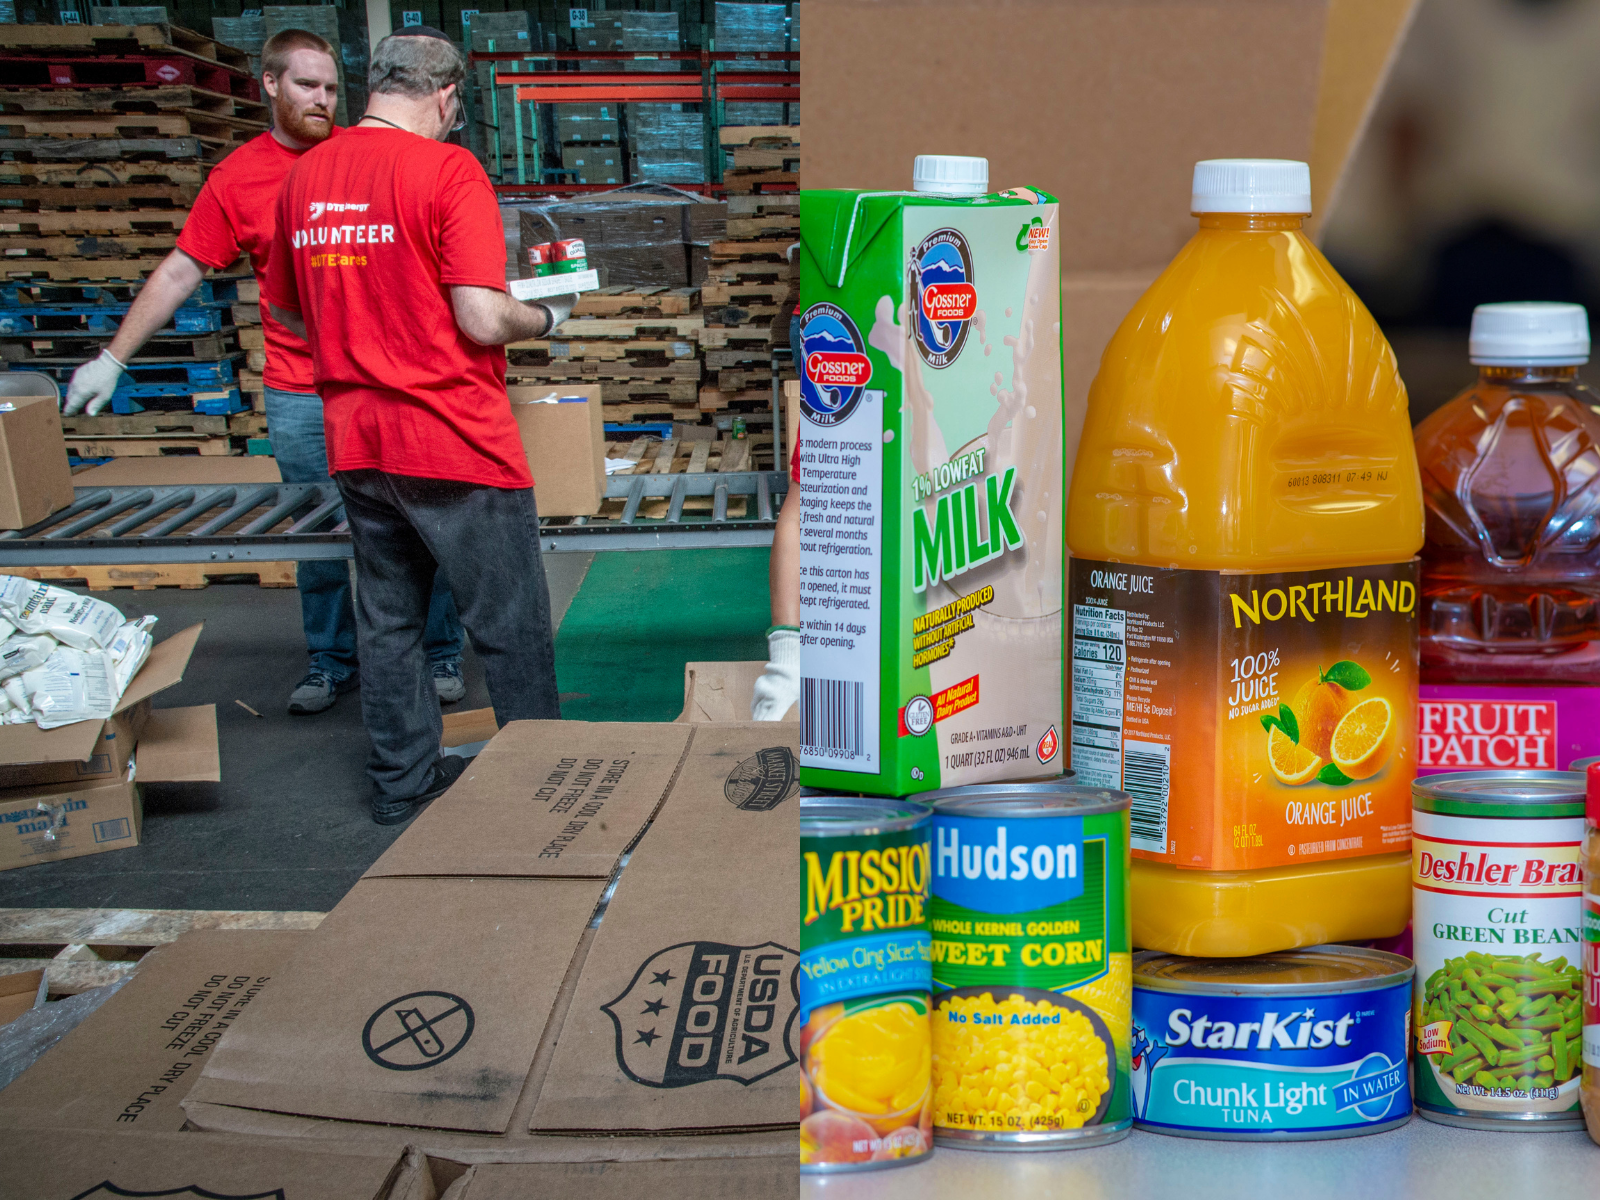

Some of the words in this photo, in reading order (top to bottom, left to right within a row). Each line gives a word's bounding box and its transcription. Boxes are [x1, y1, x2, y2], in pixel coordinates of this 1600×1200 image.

[405, 13, 420, 23] G-40
[572, 10, 586, 21] G-38
[292, 224, 395, 249] VOLUNTEER
[1028, 227, 1050, 238] NEW!
[922, 232, 962, 252] Premium
[310, 252, 368, 268] #DTEares
[925, 286, 972, 319] Gossner
[804, 305, 843, 323] Premium
[937, 309, 964, 317] FOODS
[808, 353, 865, 382] Gossner
[927, 353, 948, 365] Milk
[823, 374, 857, 383] FOODS
[811, 411, 836, 423] Milk
[805, 438, 838, 450] modern
[840, 441, 873, 452] process
[818, 453, 839, 464] Ultra
[841, 454, 861, 467] High
[802, 467, 857, 480] Temperature
[912, 473, 932, 503] 1%
[933, 447, 986, 494] LOWFAT
[1312, 472, 1341, 485] 808311
[851, 485, 868, 496] and
[830, 498, 856, 512] keeps
[857, 500, 872, 511] the
[802, 511, 824, 524] fresh
[825, 514, 842, 524] and
[843, 515, 875, 526] natural
[804, 528, 834, 539] several
[835, 529, 868, 540] months
[912, 465, 1024, 594] MILK
[818, 542, 873, 556] refrigeration.
[809, 566, 824, 577] this
[825, 568, 852, 579] carton
[854, 568, 870, 580] has
[1090, 569, 1128, 591] ORANGE
[1128, 574, 1155, 595] JUICE
[807, 582, 840, 595] opened,
[849, 584, 872, 595] must
[818, 596, 871, 610] refrigerated.
[913, 602, 957, 635] NATURALLY
[956, 585, 994, 617] PRODUCED
[1229, 576, 1416, 629] NORTHLAND
[1075, 604, 1103, 619] Nutrition
[1104, 609, 1125, 621] Facts
[806, 619, 832, 631] within
[834, 622, 844, 632] 14
[846, 622, 867, 636] days
[913, 626, 944, 652] WITHOUT
[943, 613, 975, 640] ARTIFICIAL
[820, 636, 856, 650] opening.
[1074, 645, 1098, 659] Calories
[1102, 643, 1122, 662] 120
[1230, 647, 1281, 683] 100%
[936, 692, 947, 708] All
[946, 678, 974, 703] Natural
[1228, 672, 1279, 706] JUICE
[936, 702, 954, 719] Dairy
[953, 690, 977, 711] Product
[1126, 701, 1143, 713] ME/HI
[1151, 704, 1173, 717] Deposit
[1228, 707, 1240, 720] NO
[1240, 702, 1261, 716] SUGAR
[911, 718, 928, 726] FREE
[1419, 702, 1548, 735] FRUIT
[950, 731, 969, 745] GRADE
[976, 727, 1002, 741] VITAMINS
[1016, 724, 1028, 736] UHT
[827, 748, 856, 760] 09908
[950, 751, 974, 770] QUART
[974, 750, 986, 768] (32
[994, 747, 1006, 764] OZ)
[1006, 746, 1019, 761] 946
[1019, 744, 1030, 760] mL
[1419, 734, 1549, 767] PATCH
[556, 758, 578, 769] DO
[583, 758, 604, 770] DO
[601, 759, 631, 784] STORE
[765, 751, 787, 781] MARKET
[544, 770, 570, 787] NOT
[571, 771, 597, 788] NOT
[532, 787, 558, 802] CUT
[594, 785, 616, 794] IN
[749, 782, 784, 808] STREET
[549, 788, 586, 814] FREEZE
[574, 801, 605, 819] COOL
[1285, 800, 1337, 826] ORANGE
[1340, 792, 1374, 827] JUICE
[1160, 801, 1168, 833] 53792
[561, 820, 589, 836] DRY
[1233, 825, 1241, 837] 64
[1248, 823, 1257, 836] OZ
[538, 835, 576, 859] PLACE
[937, 826, 1078, 881] Hudson
[1418, 850, 1520, 886] Deshler
[840, 893, 926, 933] PRIDE
[1487, 906, 1529, 925] Cut
[932, 919, 972, 935] WHOLE
[974, 922, 1025, 937] KERNEL
[1026, 920, 1081, 937] GOLDEN
[1432, 922, 1506, 945] GREEN
[930, 939, 1011, 967] WEET
[1020, 938, 1103, 967] CORN
[800, 956, 850, 980] Yellow
[204, 974, 228, 988] DO
[227, 975, 251, 990] DO
[736, 965, 749, 1007] DEPARTMENT
[183, 990, 213, 1010] NOT
[206, 991, 236, 1012] NOT
[221, 1009, 242, 1020] IN
[678, 954, 730, 1068] FOOD
[737, 954, 784, 1066] USDA
[948, 1011, 967, 1024] No
[972, 1012, 1003, 1025] Salt
[1010, 1012, 1061, 1026] Added
[160, 1011, 190, 1032] CUT
[212, 1021, 230, 1030] A
[1165, 1007, 1355, 1051] StarKist
[165, 1013, 215, 1051] FREEZE
[725, 1018, 740, 1064] AGRICULTURE
[1422, 1026, 1439, 1038] Low
[183, 1032, 222, 1058] COOL
[1419, 1036, 1448, 1050] Sodium
[159, 1062, 193, 1084] DRY
[1343, 1086, 1360, 1103] IN
[1362, 1070, 1401, 1097] WATER
[1455, 1083, 1469, 1095] Net
[1469, 1085, 1488, 1097] Wt.
[1489, 1087, 1511, 1098] 14.5
[1513, 1088, 1528, 1098] oz.
[1529, 1086, 1560, 1099] (411g)
[116, 1085, 168, 1123] PLACE
[1173, 1079, 1258, 1107] Chunk
[1263, 1081, 1328, 1114] Light
[946, 1112, 965, 1124] NET
[968, 1115, 986, 1126] WT.
[991, 1116, 1003, 1126] 15
[1007, 1116, 1025, 1127] OZ.
[1030, 1115, 1065, 1127] (425g)
[1221, 1108, 1273, 1124] TUNA
